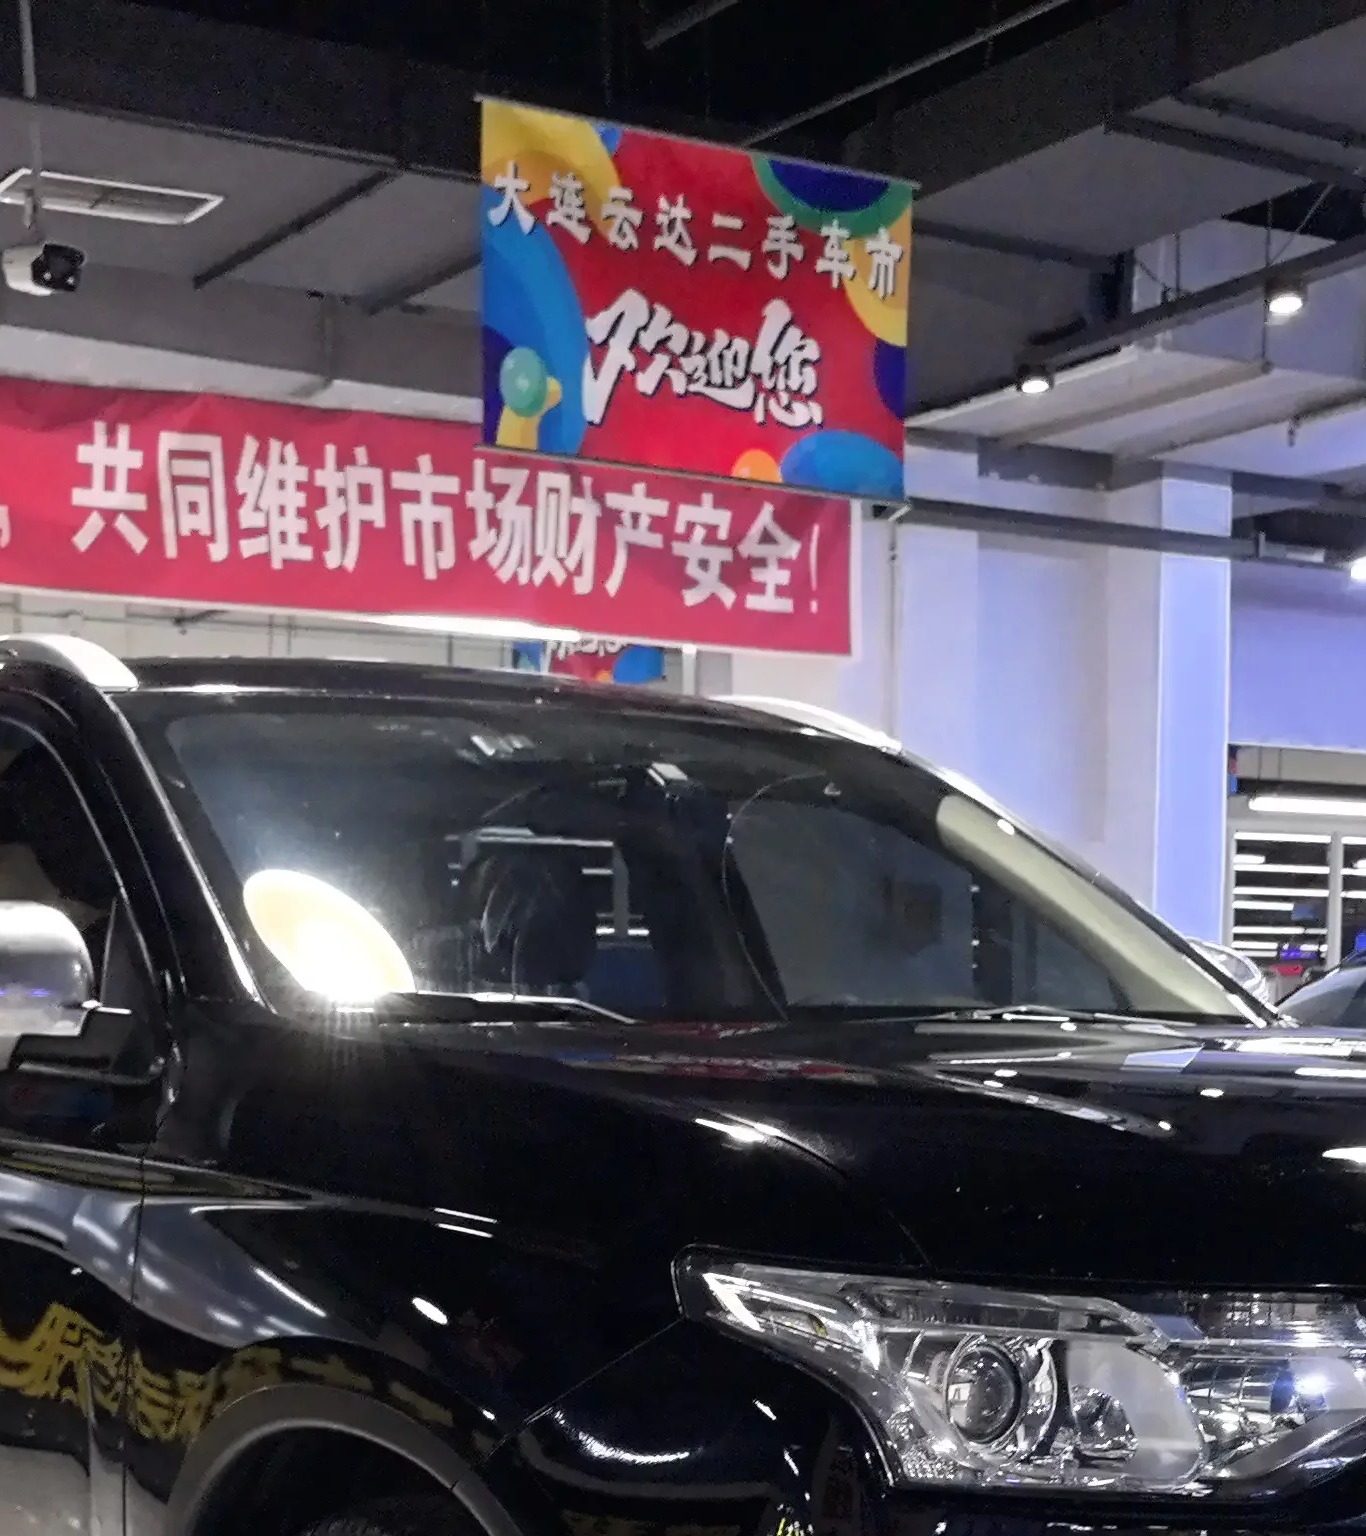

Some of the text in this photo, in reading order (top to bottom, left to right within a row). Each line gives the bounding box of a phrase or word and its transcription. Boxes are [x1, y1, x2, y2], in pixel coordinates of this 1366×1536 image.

[487, 161, 903, 299] 大连云达二手车市
[581, 287, 823, 428] 欢迎您
